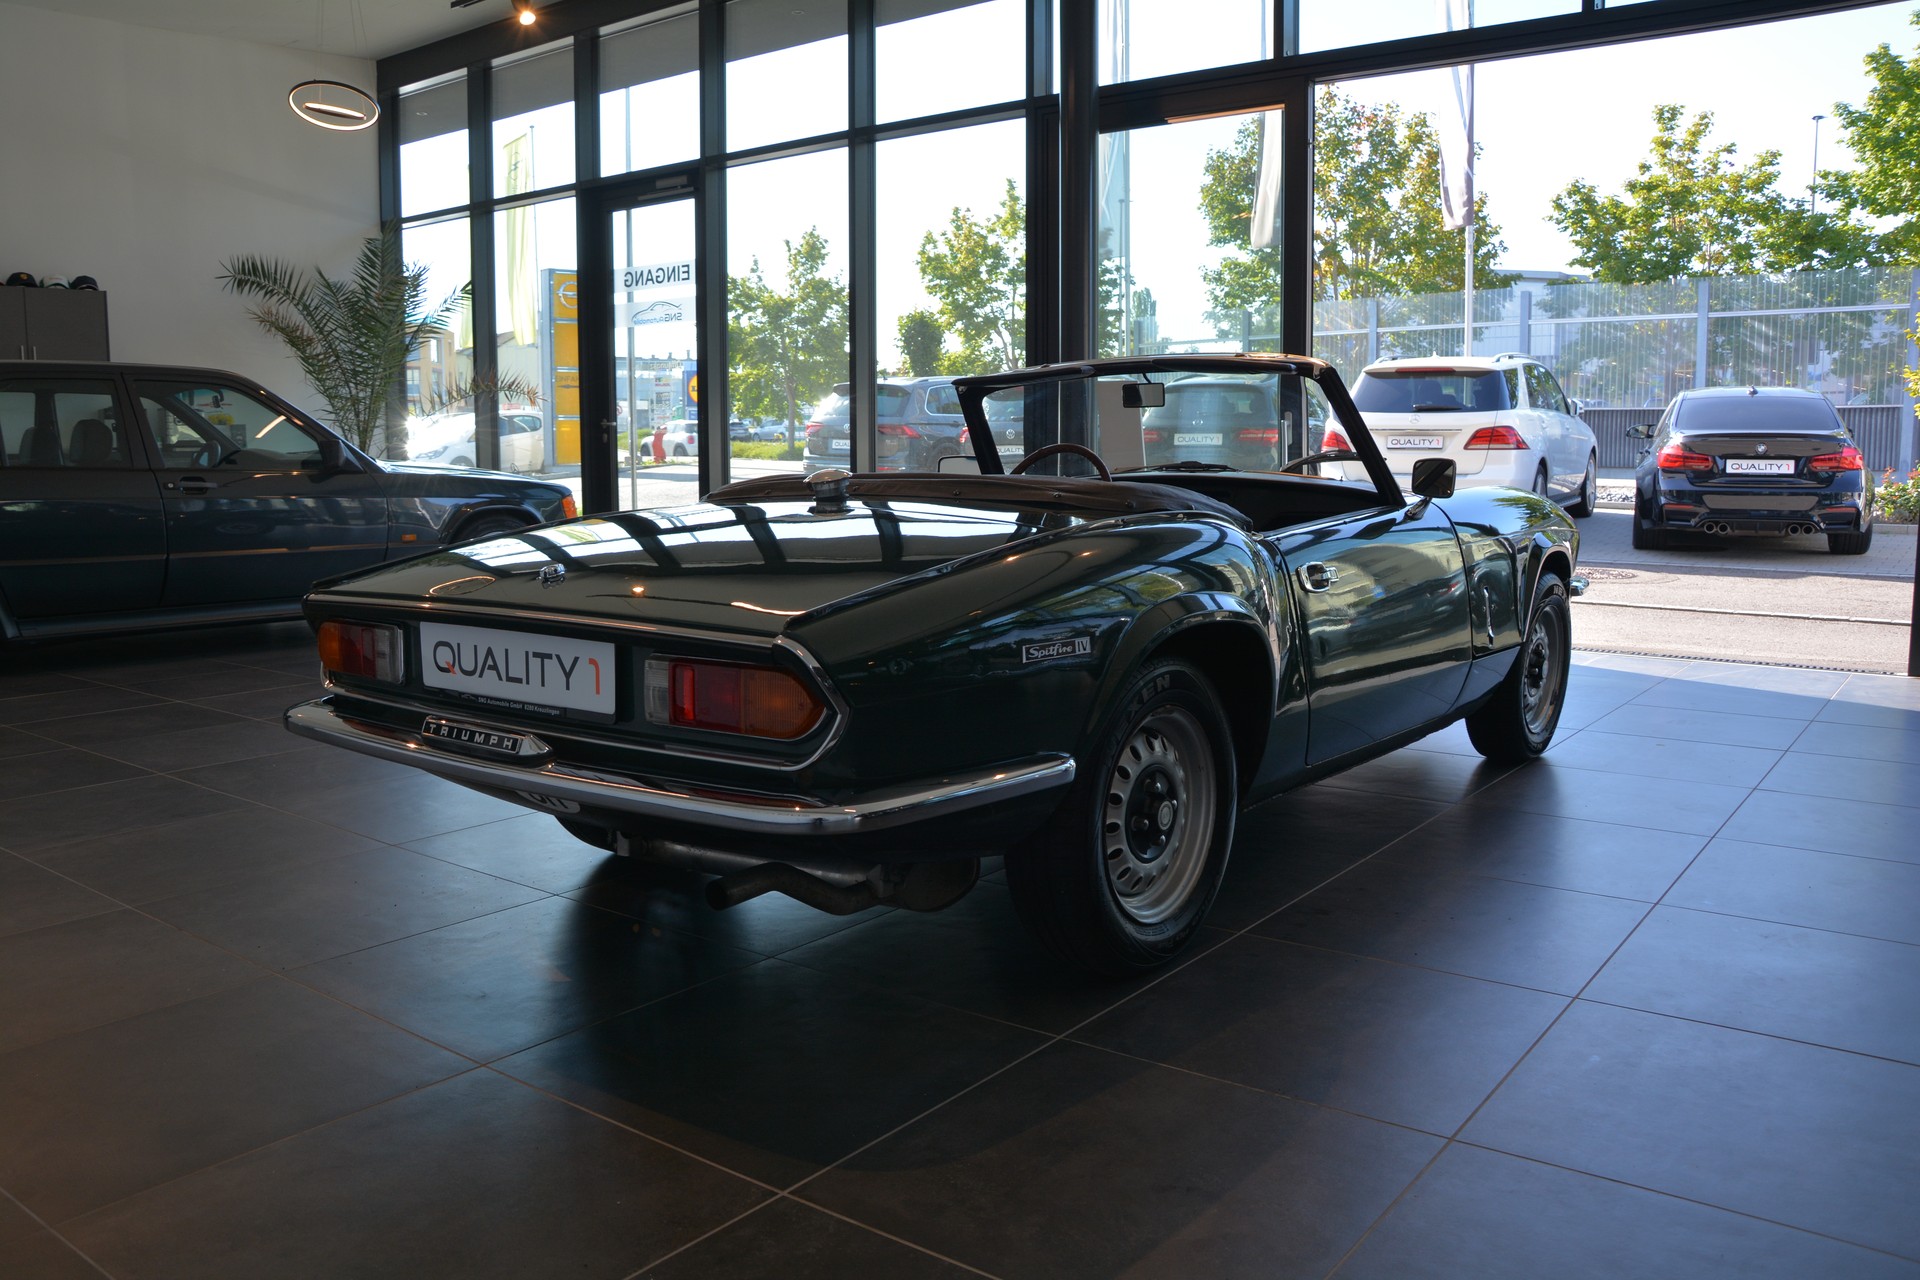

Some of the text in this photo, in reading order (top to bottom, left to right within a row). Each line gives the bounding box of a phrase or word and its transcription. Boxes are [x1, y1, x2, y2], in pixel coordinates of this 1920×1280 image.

[1390, 438, 1434, 446] QUALITY
[1731, 462, 1783, 471] QUALITY
[1028, 640, 1088, 658] Spitfire IV
[433, 640, 601, 696] QUALITY 1
[487, 698, 509, 708] Automobile
[510, 701, 523, 709] GmbH
[429, 723, 513, 750] TRIUMPH
